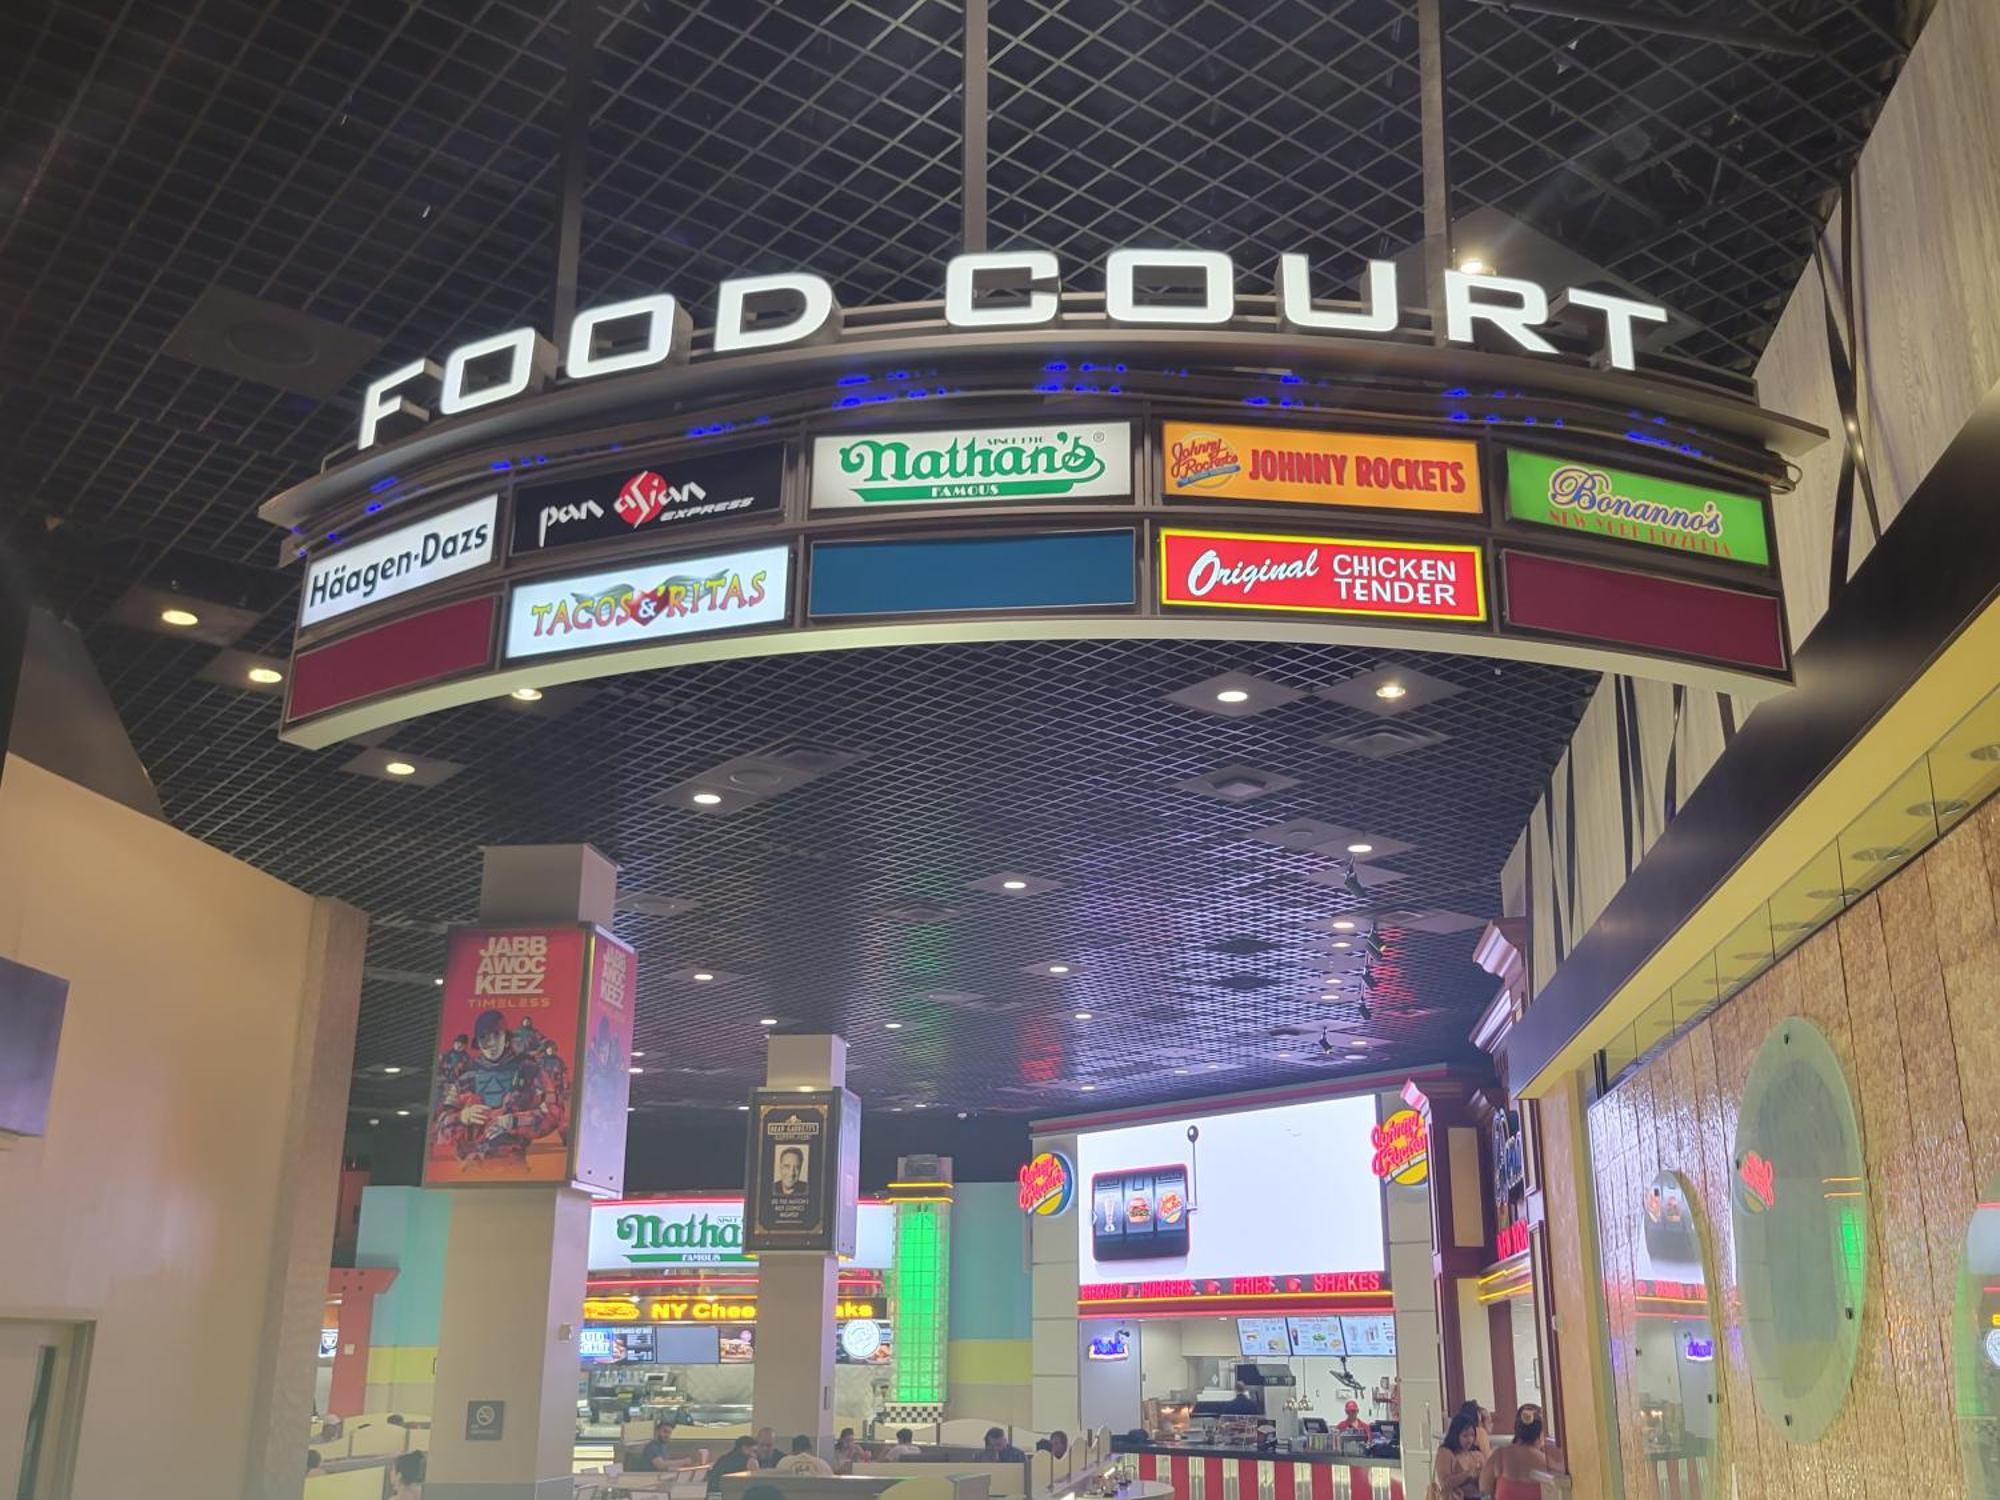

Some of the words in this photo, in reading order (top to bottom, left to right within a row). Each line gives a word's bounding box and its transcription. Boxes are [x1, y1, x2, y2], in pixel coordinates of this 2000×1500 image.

[358, 272, 834, 450] FOOD
[945, 249, 1668, 371] COURT
[839, 432, 1104, 482] Nathan's
[1171, 438, 1230, 478] Johnny
[1249, 449, 1347, 485] JOHNNY
[1355, 456, 1465, 493] ROCKETS
[930, 483, 999, 498] FAMOUS
[1549, 466, 1722, 536] Bonanno's
[539, 499, 604, 547] pan
[1187, 548, 1319, 596] Original
[1332, 553, 1457, 582] CHICKEN
[531, 590, 634, 637] TACOS
[640, 598, 658, 619] &
[656, 570, 767, 618] RITAS
[1333, 577, 1457, 606] TENDER
[479, 935, 548, 956] JABB
[477, 956, 547, 974] AWOC
[474, 974, 545, 995] KEEZ
[468, 998, 552, 1009] TIMELESS
[1232, 1277, 1272, 1295] FRIES
[1313, 1272, 1380, 1292] SHAKES
[651, 1303, 688, 1320] NY
